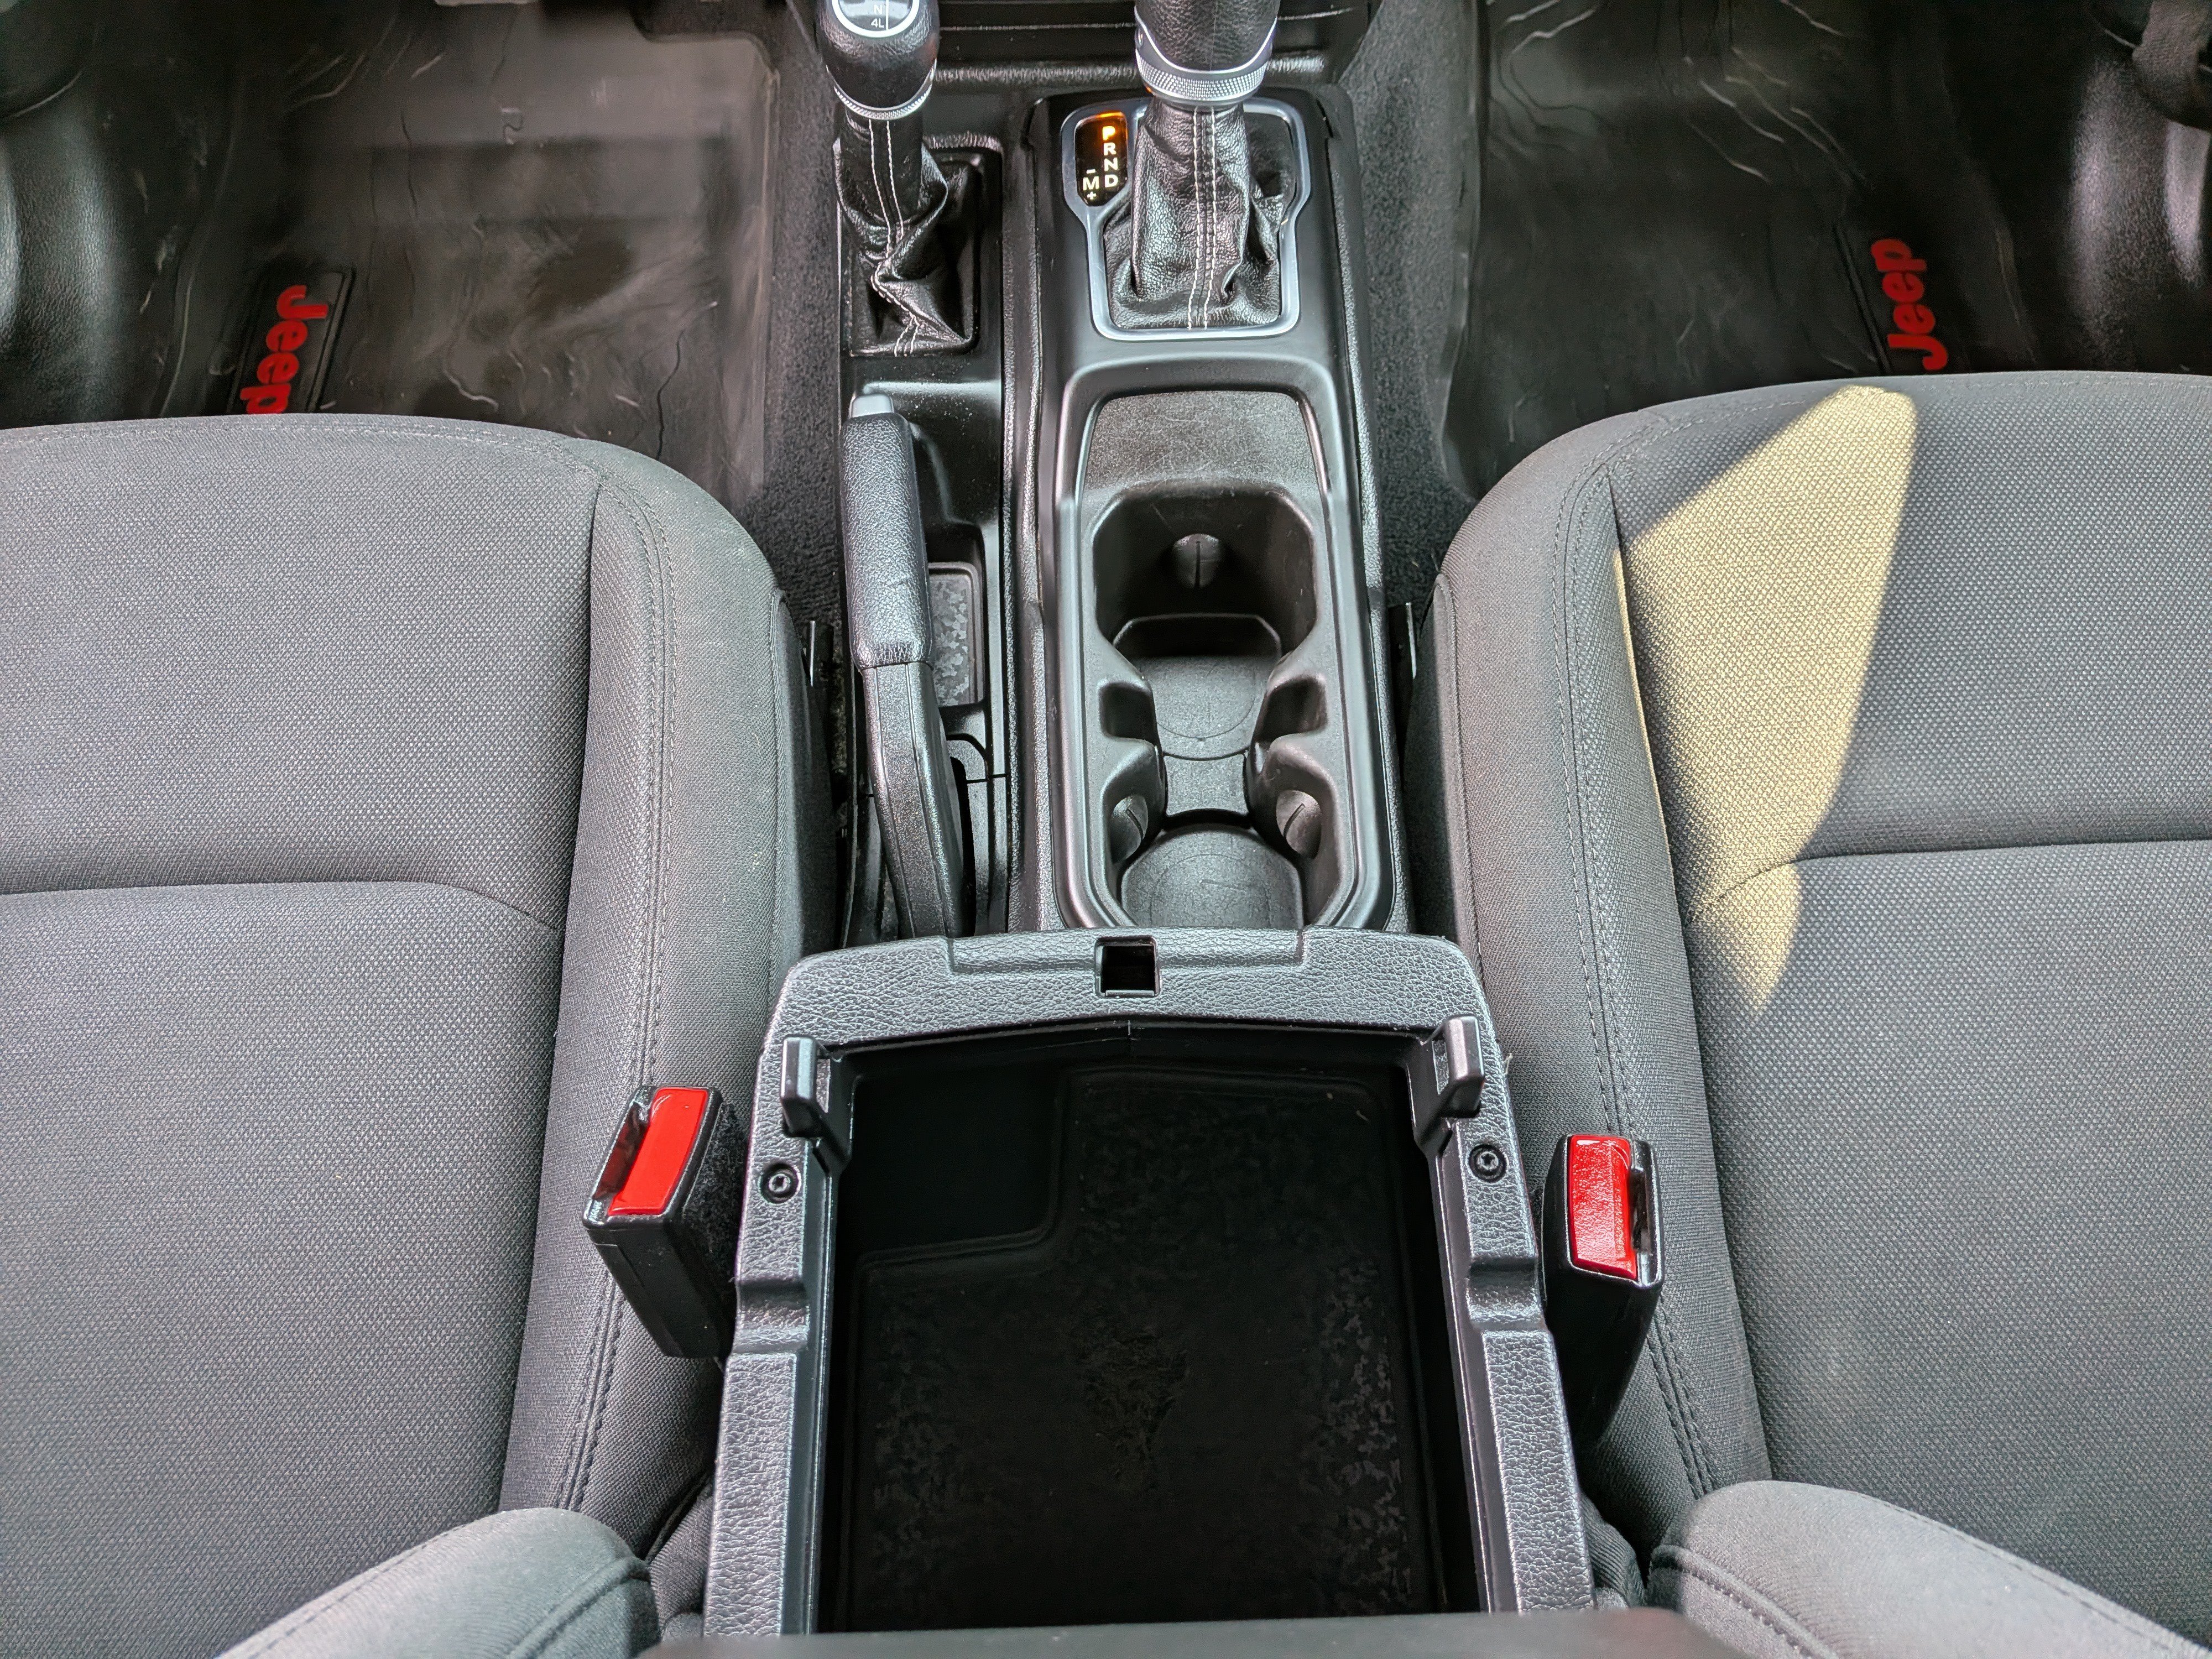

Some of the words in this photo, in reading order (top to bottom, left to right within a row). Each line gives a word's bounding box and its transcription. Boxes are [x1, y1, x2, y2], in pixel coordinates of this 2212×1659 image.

[874, 4, 883, 14] N
[870, 18, 885, 28] 4L
[1102, 126, 1116, 140] P
[1103, 142, 1117, 155] R
[1104, 157, 1118, 171] N
[1083, 176, 1099, 191] M
[1104, 174, 1118, 187] D
[1870, 238, 1948, 371] Jeep
[240, 284, 329, 414] Jeep
